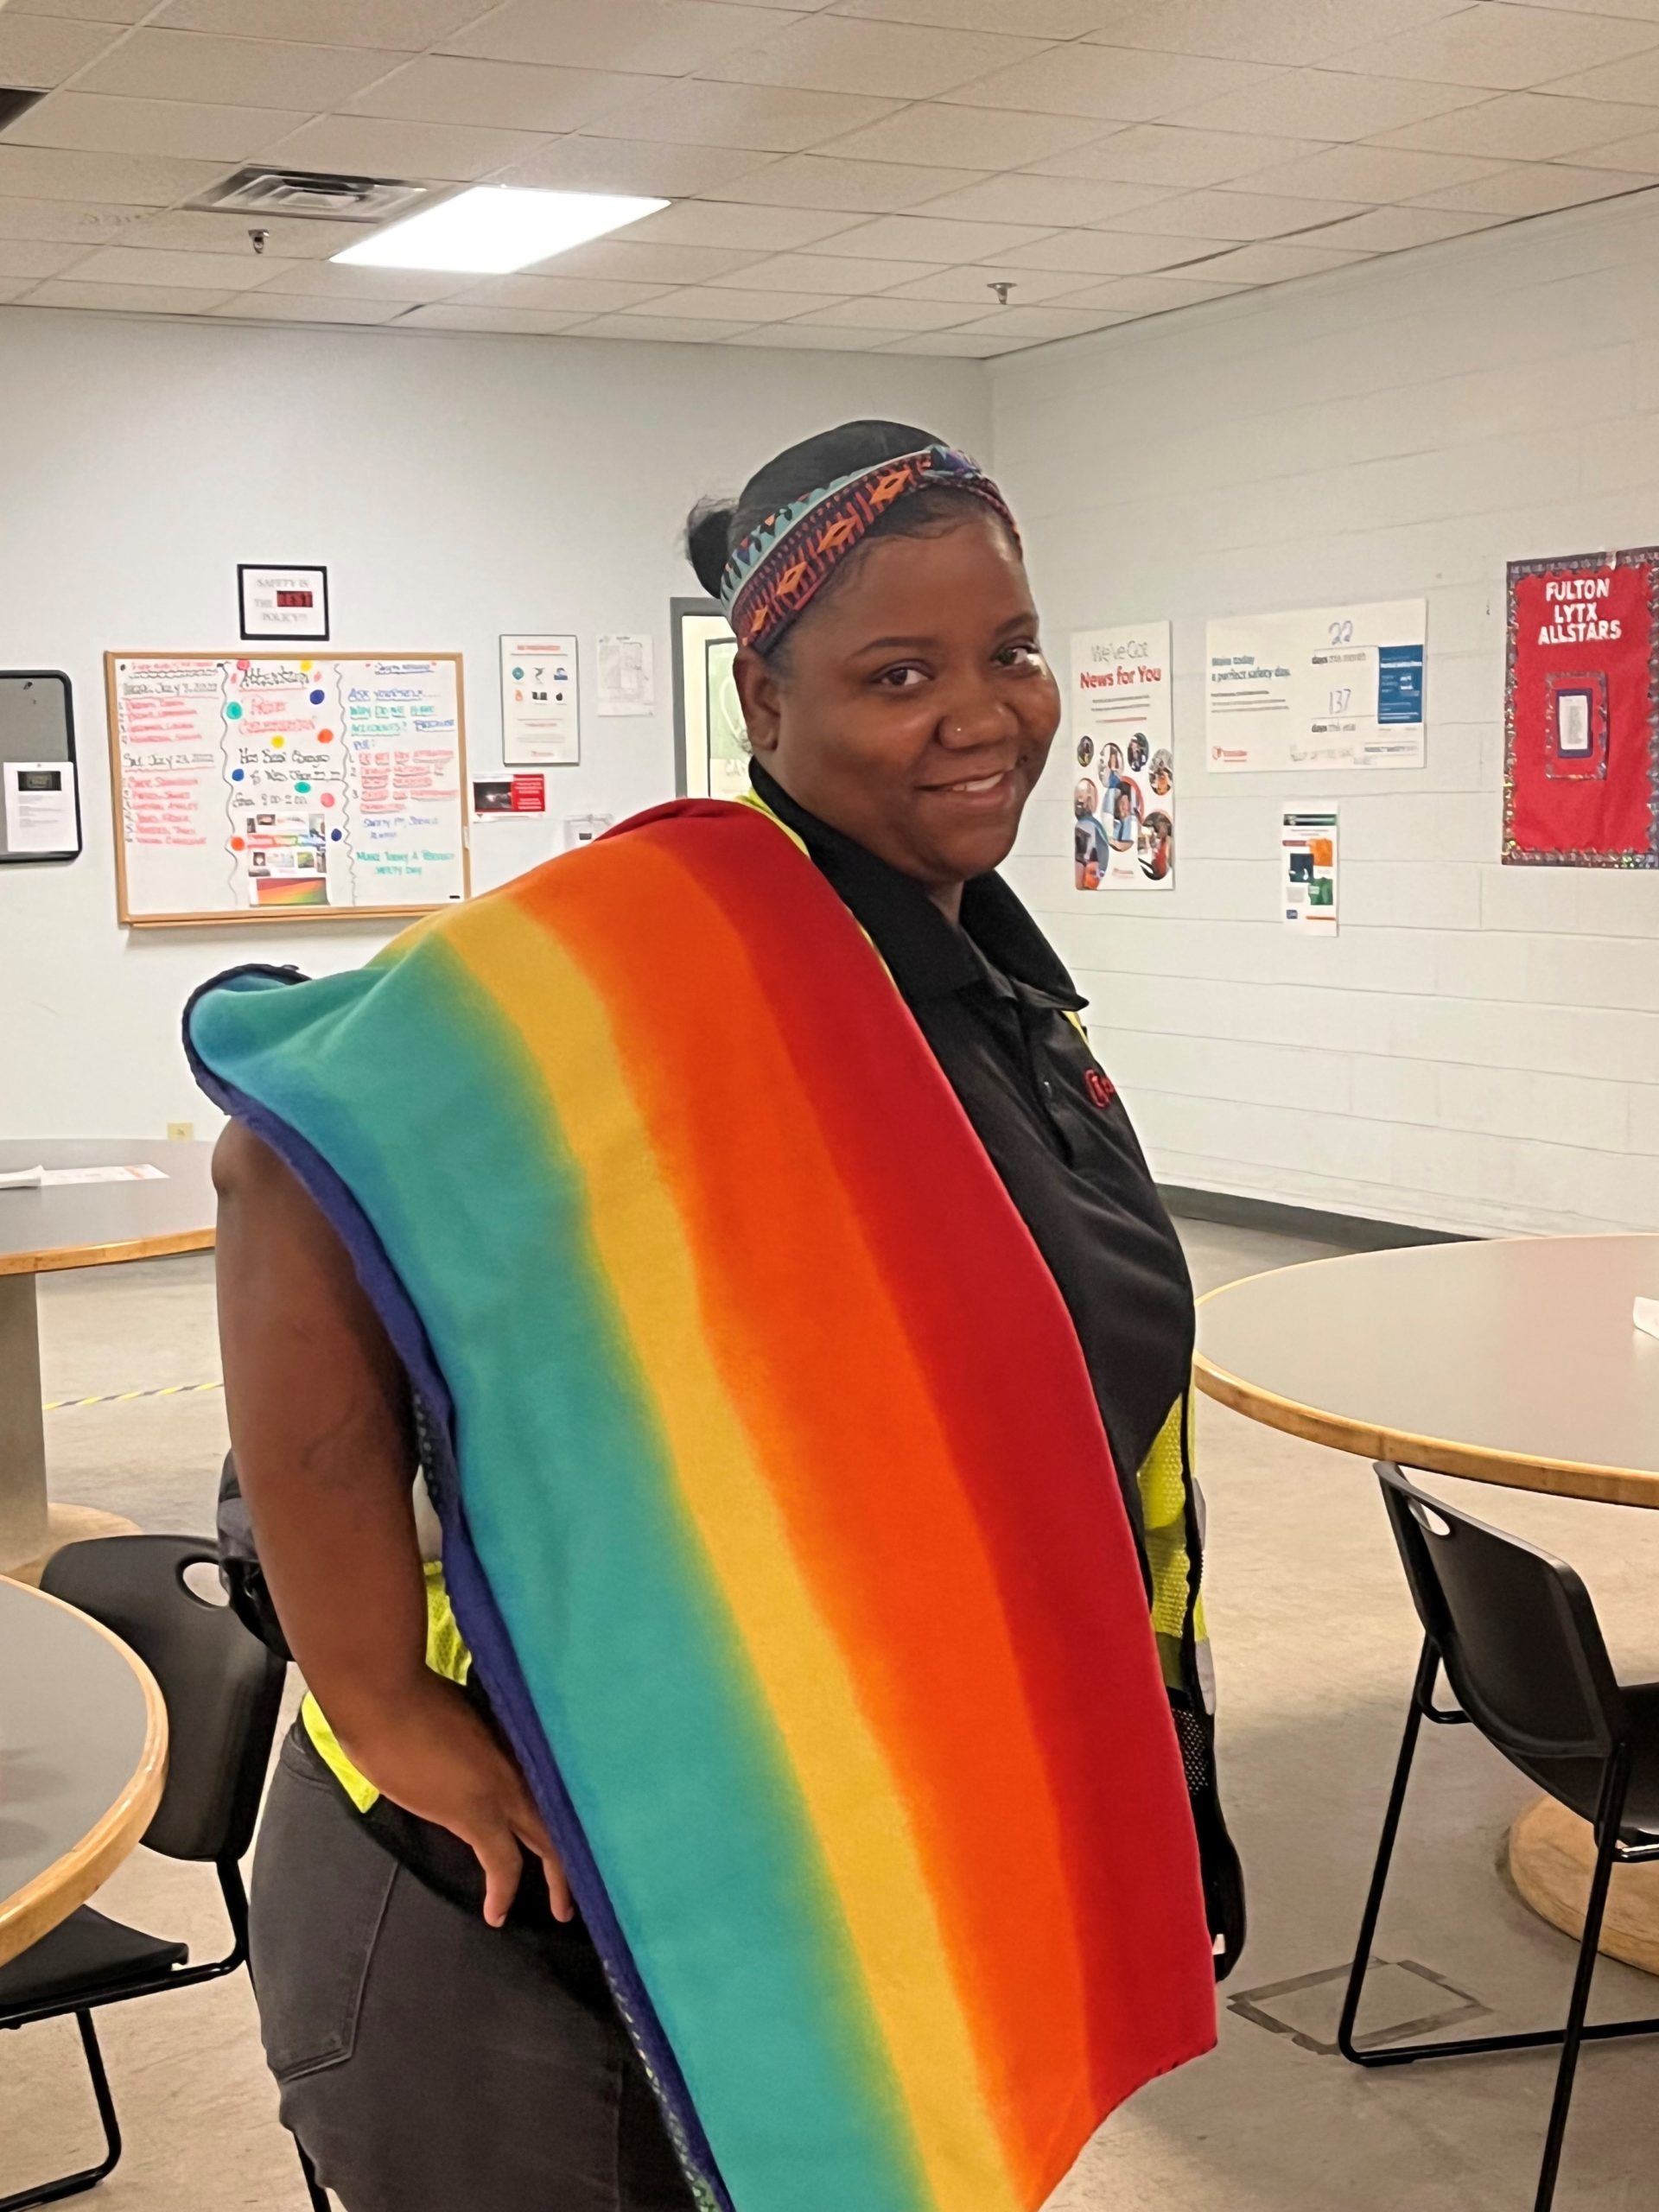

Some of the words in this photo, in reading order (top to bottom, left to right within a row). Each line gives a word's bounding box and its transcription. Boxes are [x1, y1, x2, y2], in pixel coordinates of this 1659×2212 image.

[1545, 578, 1610, 601] FULTON
[1554, 602, 1598, 624] LYTX
[1328, 620, 1353, 645] 22
[1538, 620, 1622, 645] ALLSTARS
[1080, 671, 1114, 689] News
[1116, 665, 1135, 685] for
[1137, 665, 1162, 683] You
[1328, 689, 1351, 715] 137
